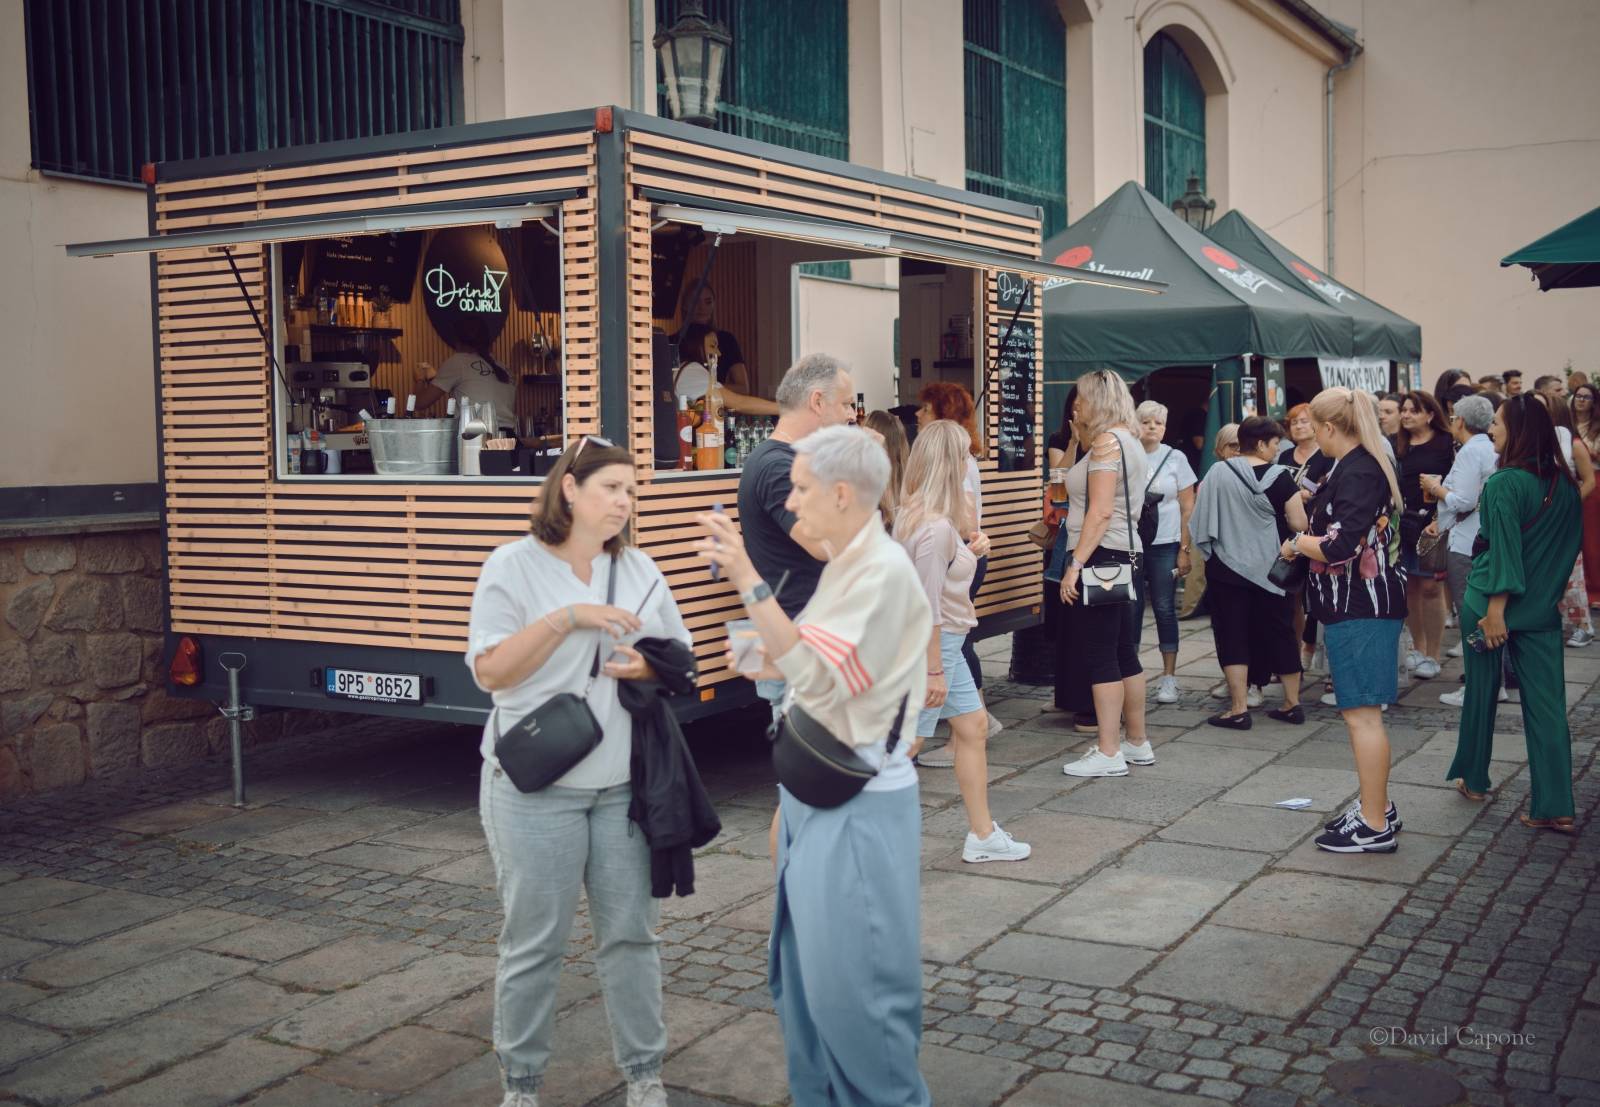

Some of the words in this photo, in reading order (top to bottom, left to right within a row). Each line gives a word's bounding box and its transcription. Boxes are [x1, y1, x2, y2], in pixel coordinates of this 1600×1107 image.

[459, 298, 475, 312] OD
[328, 684, 335, 692] CZ
[338, 673, 364, 694] 9P5
[375, 677, 412, 698] 8652
